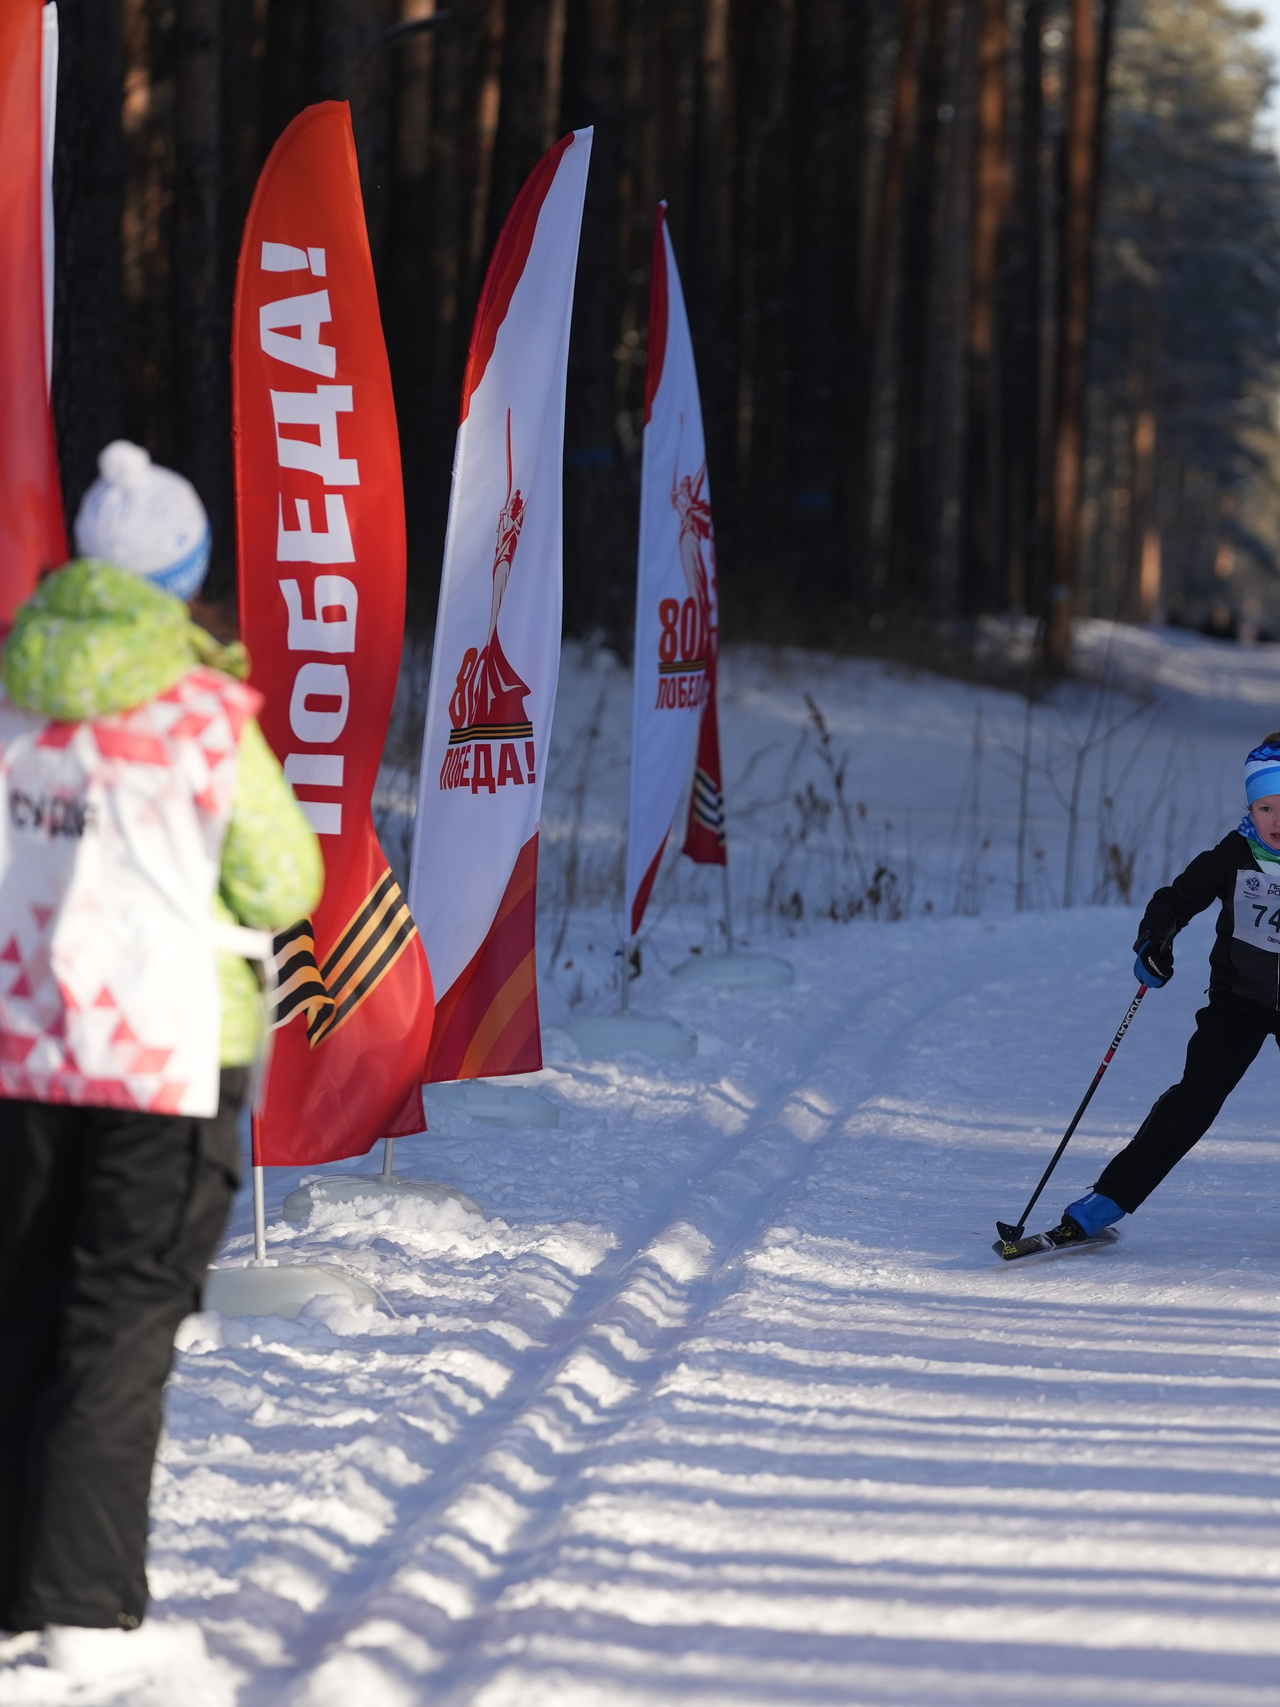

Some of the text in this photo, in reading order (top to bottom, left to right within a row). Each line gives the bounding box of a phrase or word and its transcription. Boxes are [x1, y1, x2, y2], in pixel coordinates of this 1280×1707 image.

[259, 240, 361, 836] ПОБЕДА!
[658, 596, 697, 663] 80
[439, 740, 537, 795] ПОБЕДА!
